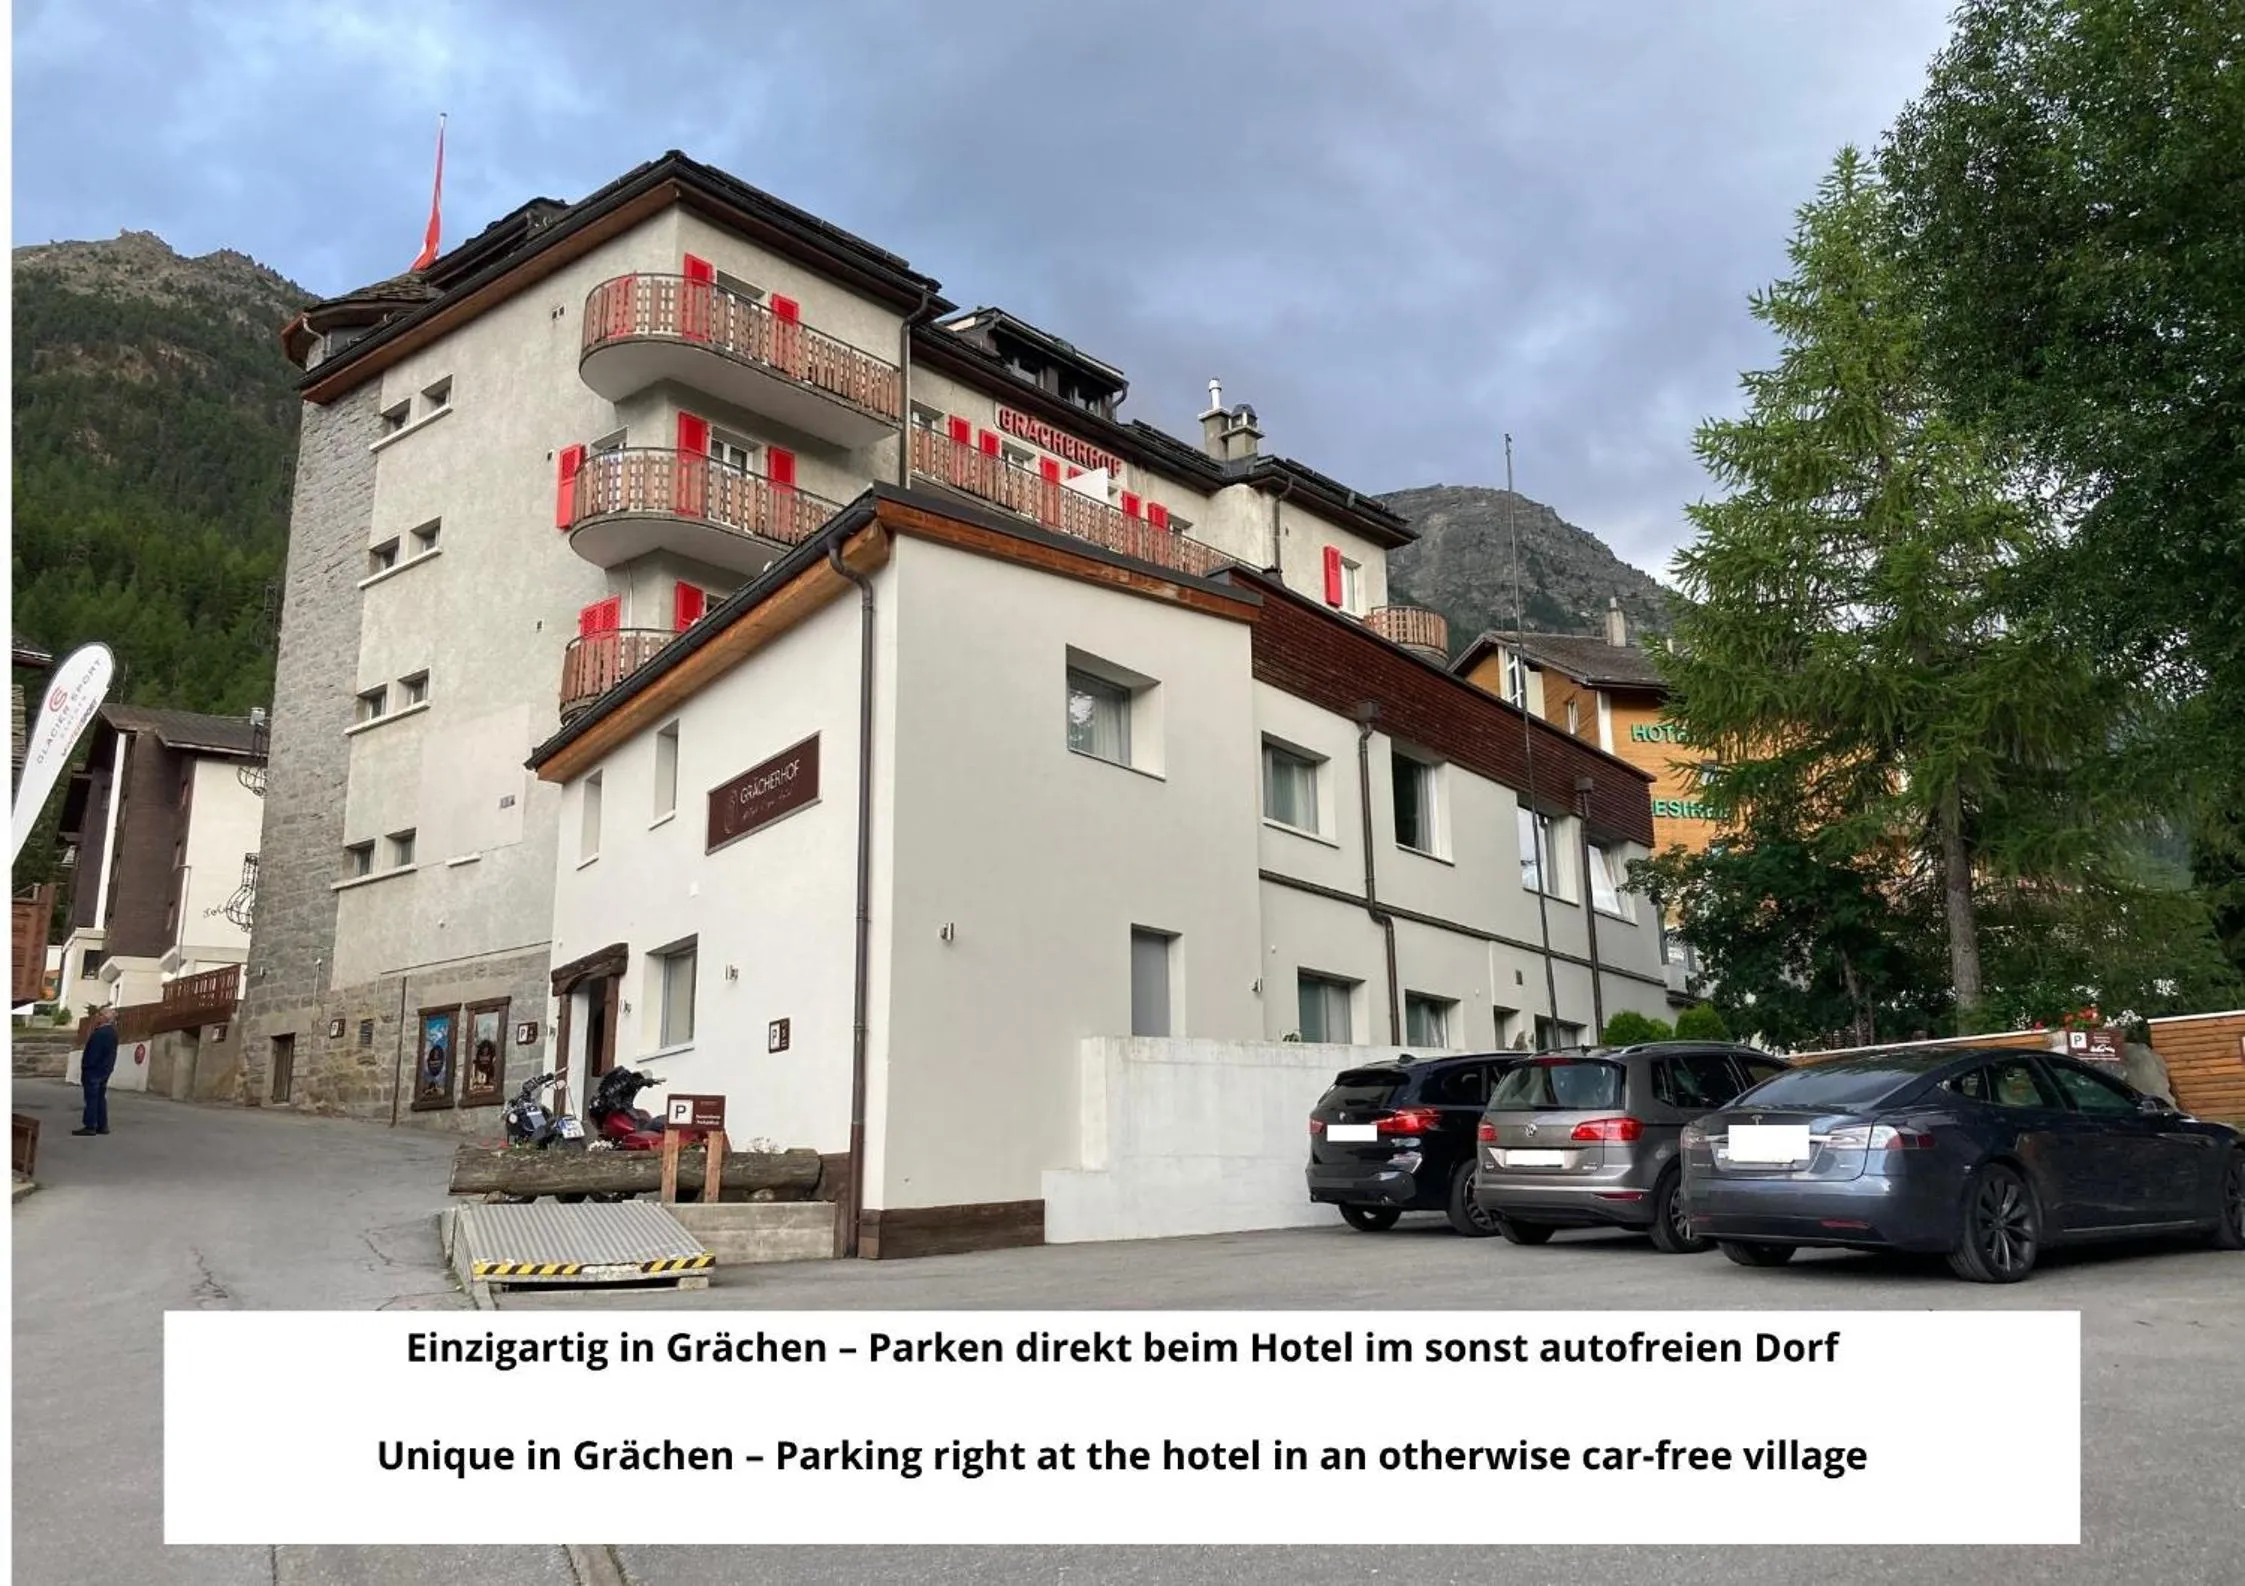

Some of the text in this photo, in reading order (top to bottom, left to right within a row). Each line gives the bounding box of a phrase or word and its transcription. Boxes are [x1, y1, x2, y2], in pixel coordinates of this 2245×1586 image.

[36, 704, 70, 765] GLACIER
[70, 659, 101, 703] SPORT
[740, 758, 800, 804] GRÄCHERHOF
[2073, 1034, 2082, 1045] P
[675, 1104, 687, 1120] P
